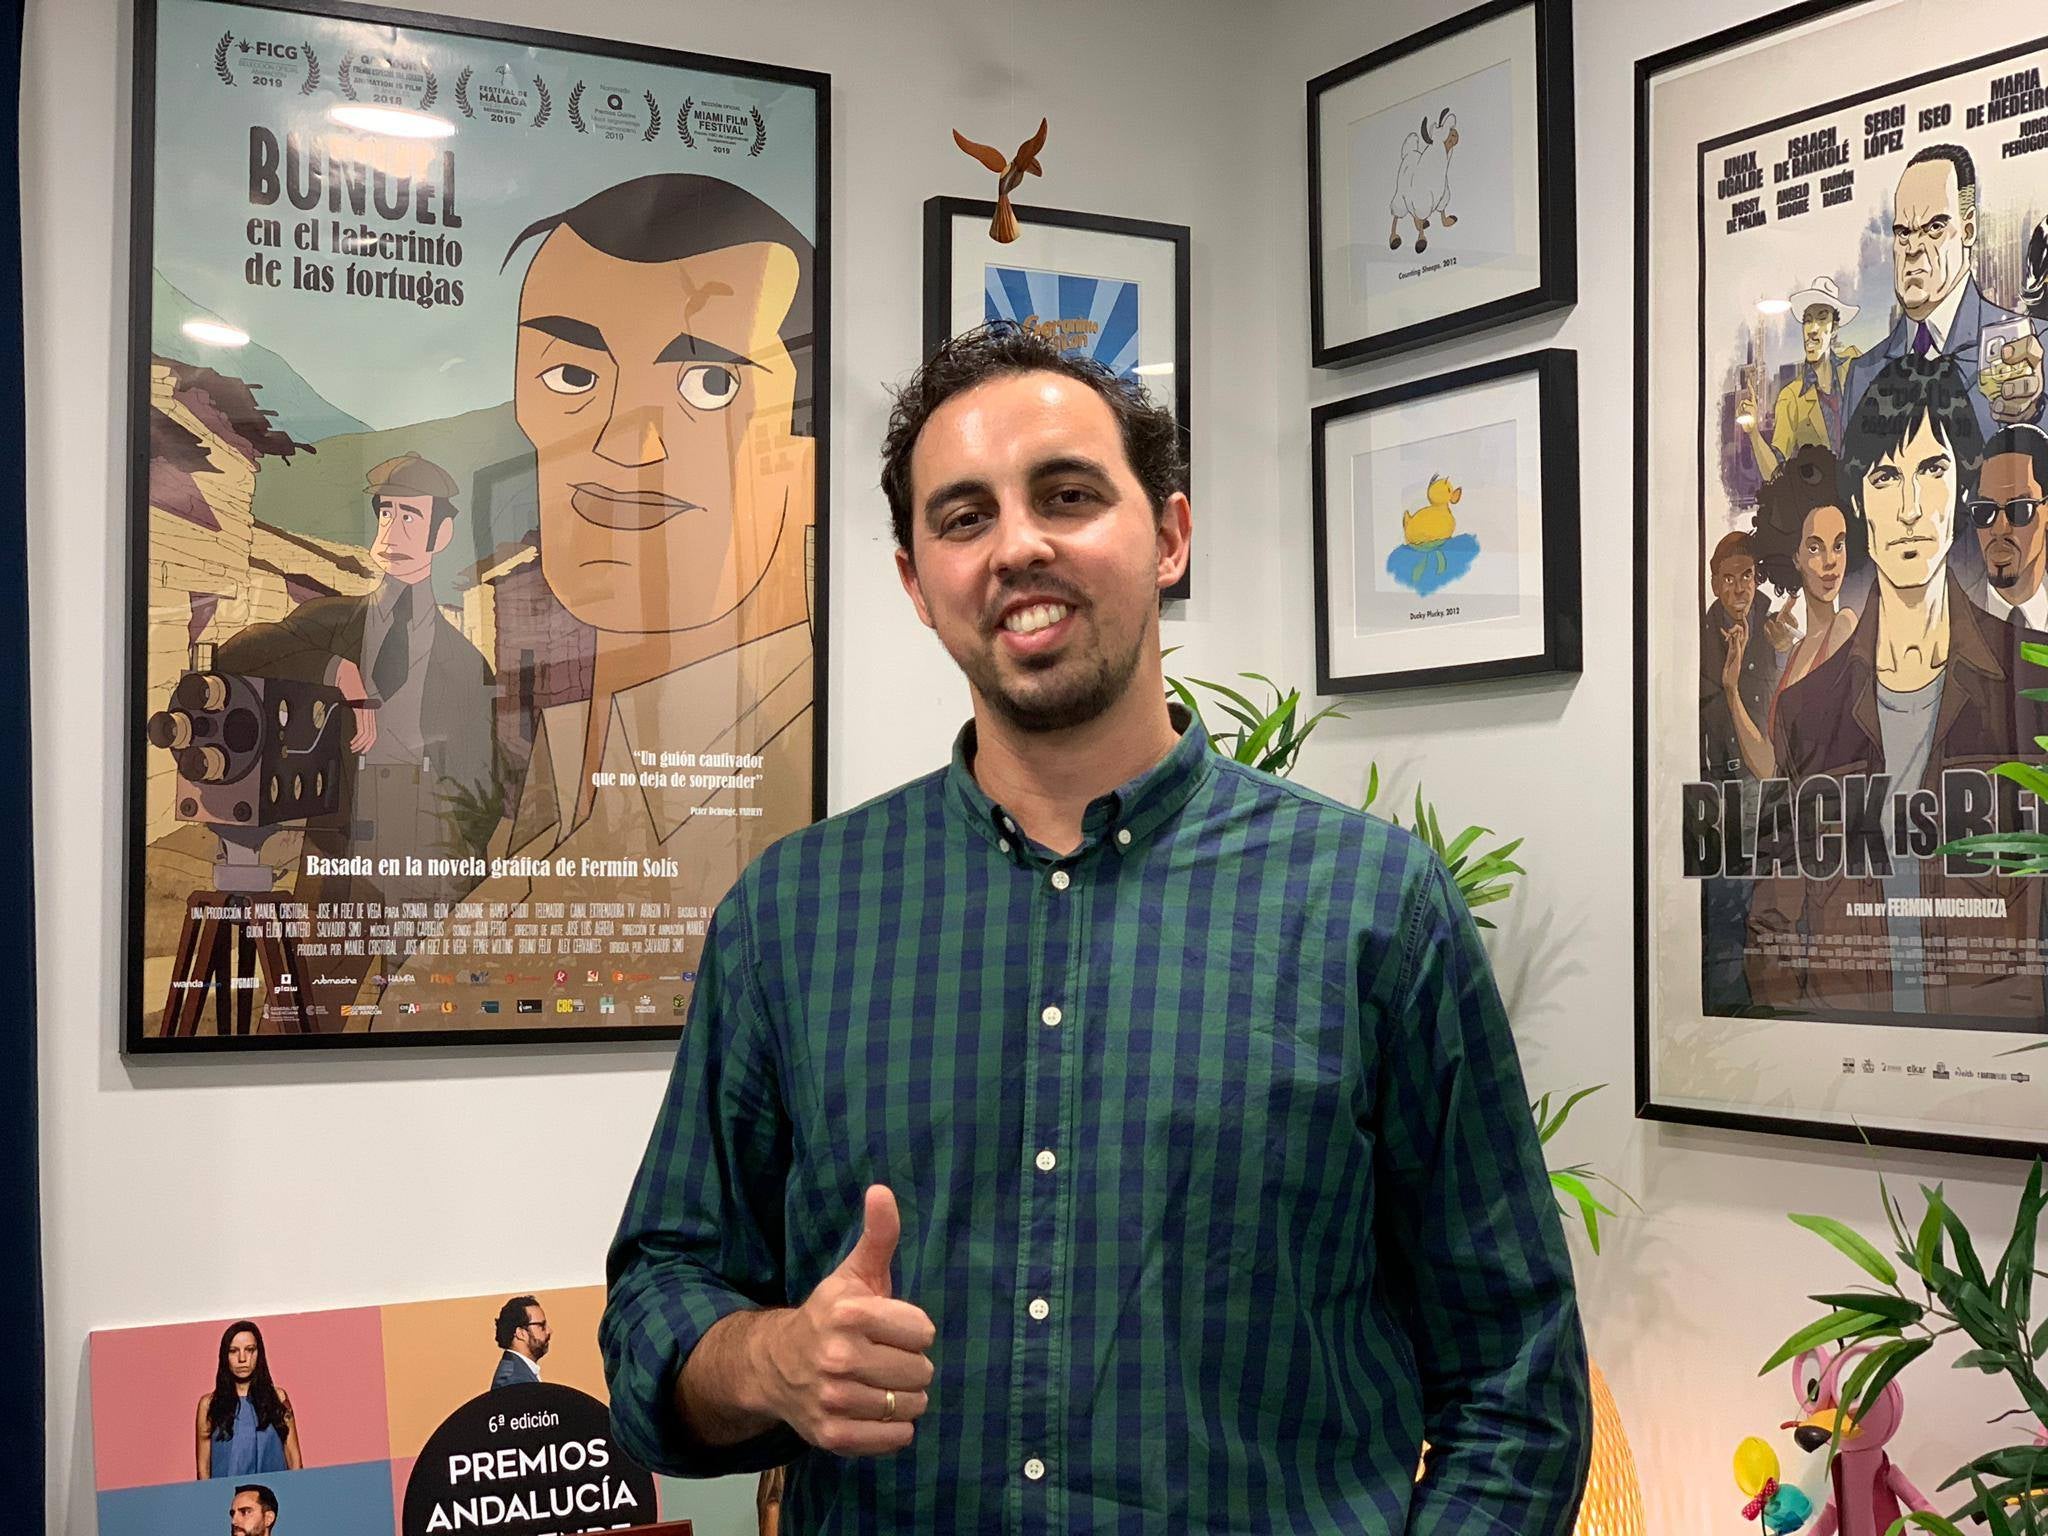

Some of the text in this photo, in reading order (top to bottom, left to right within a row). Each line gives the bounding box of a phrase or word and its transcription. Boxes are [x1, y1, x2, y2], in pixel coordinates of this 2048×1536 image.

[256, 42, 298, 60] FICG
[252, 76, 283, 88] 2019
[479, 85, 515, 96] FESTIVAL
[1990, 67, 2040, 102] MARIA
[490, 114, 516, 124] 2019
[694, 110, 748, 127] MIAMI FILM
[698, 120, 744, 136] FESTIVAL
[1864, 104, 1906, 136] SERGI
[1918, 103, 1951, 133] ISEO
[1966, 103, 1985, 130] DE
[2019, 115, 2048, 138] JORG
[605, 131, 624, 142] 2019
[1788, 126, 1837, 160] ISAACH
[1864, 129, 1904, 161] LÓPEZ
[713, 145, 730, 155] 2019
[1774, 138, 1850, 184] DE BANKOLÉ
[1724, 150, 1757, 178] UNAX
[1717, 168, 1764, 200] UGALDE
[1820, 169, 1855, 193] RAMÓN
[1776, 182, 1810, 206] ANGELO
[1726, 210, 1767, 235] DE PALMA
[246, 217, 463, 268] en el laberinto
[245, 252, 465, 309] de las tortugas
[660, 751, 696, 769] guión
[699, 752, 764, 769] cautivador
[592, 772, 616, 787] que
[619, 772, 637, 787] no
[640, 772, 667, 788] deja
[671, 772, 687, 787] de
[1682, 773, 1896, 881] BLACK
[1942, 768, 2048, 878] BE
[306, 855, 679, 880] Basada en la novela gráfica de Fermín Solís
[1845, 898, 2007, 919] A FILM BY FERMIN MUGURUZA
[173, 979, 204, 989] wanda
[274, 985, 298, 995] glow
[510, 1410, 560, 1431] edición
[448, 1438, 610, 1485] PREMIOS
[425, 1475, 639, 1533] ANDALUCÍA
